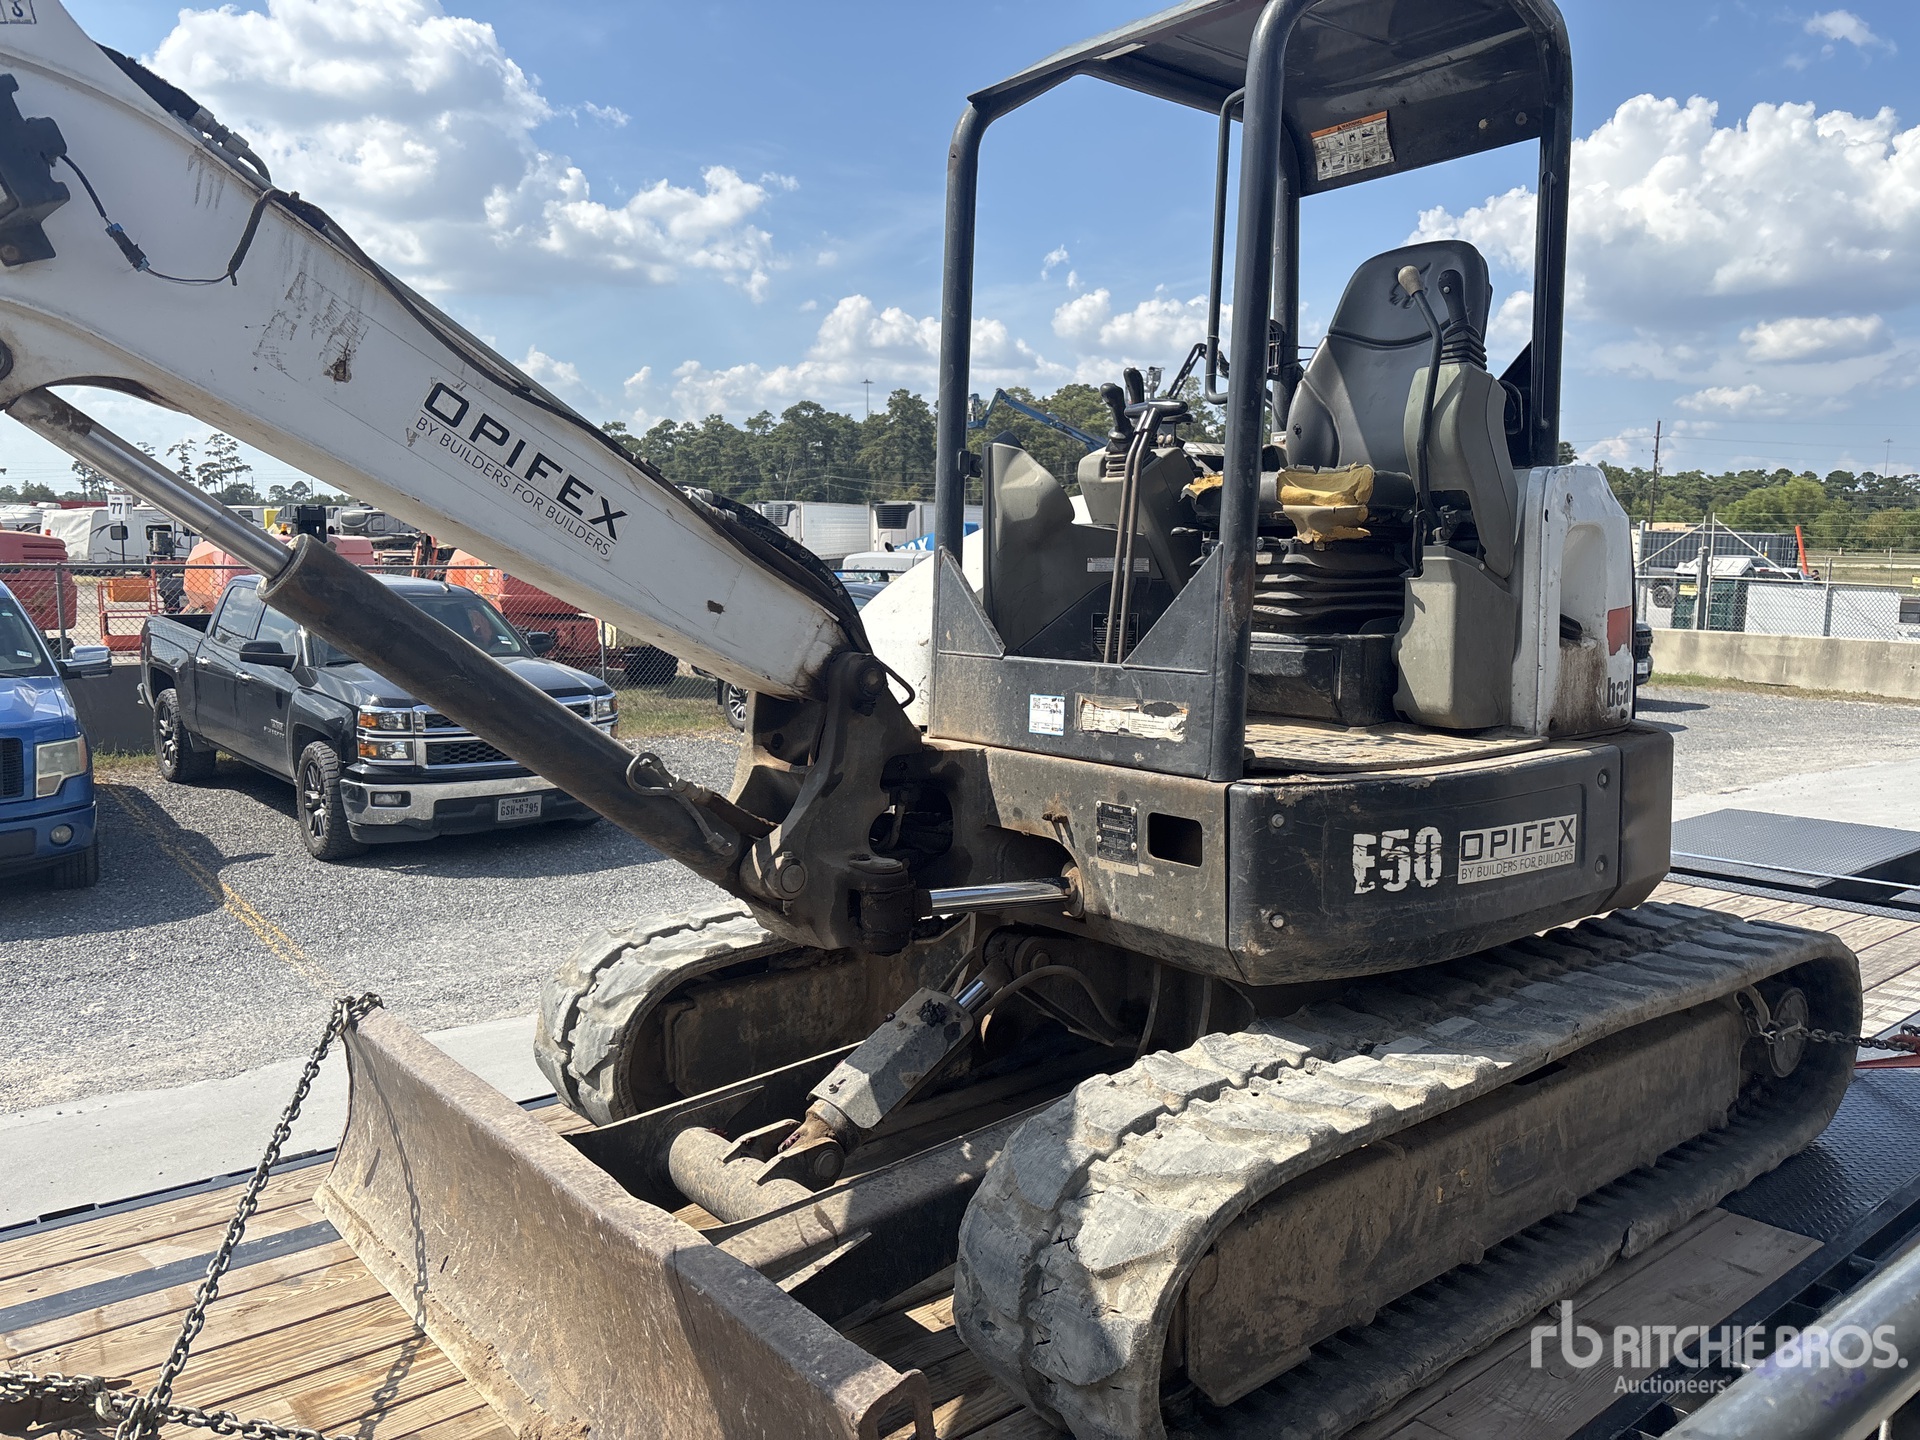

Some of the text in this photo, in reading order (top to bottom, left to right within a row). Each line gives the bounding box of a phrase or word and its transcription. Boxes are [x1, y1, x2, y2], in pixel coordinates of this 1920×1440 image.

[416, 416, 611, 556] BY BUILDERS FOR BUILDERS
[424, 382, 628, 541] OPIFEX
[110, 502, 122, 514] 77
[1352, 826, 1442, 895] E50
[1460, 817, 1575, 862] OPIFEX
[1461, 849, 1574, 881] BY BUILDERS FOR BUILDERS
